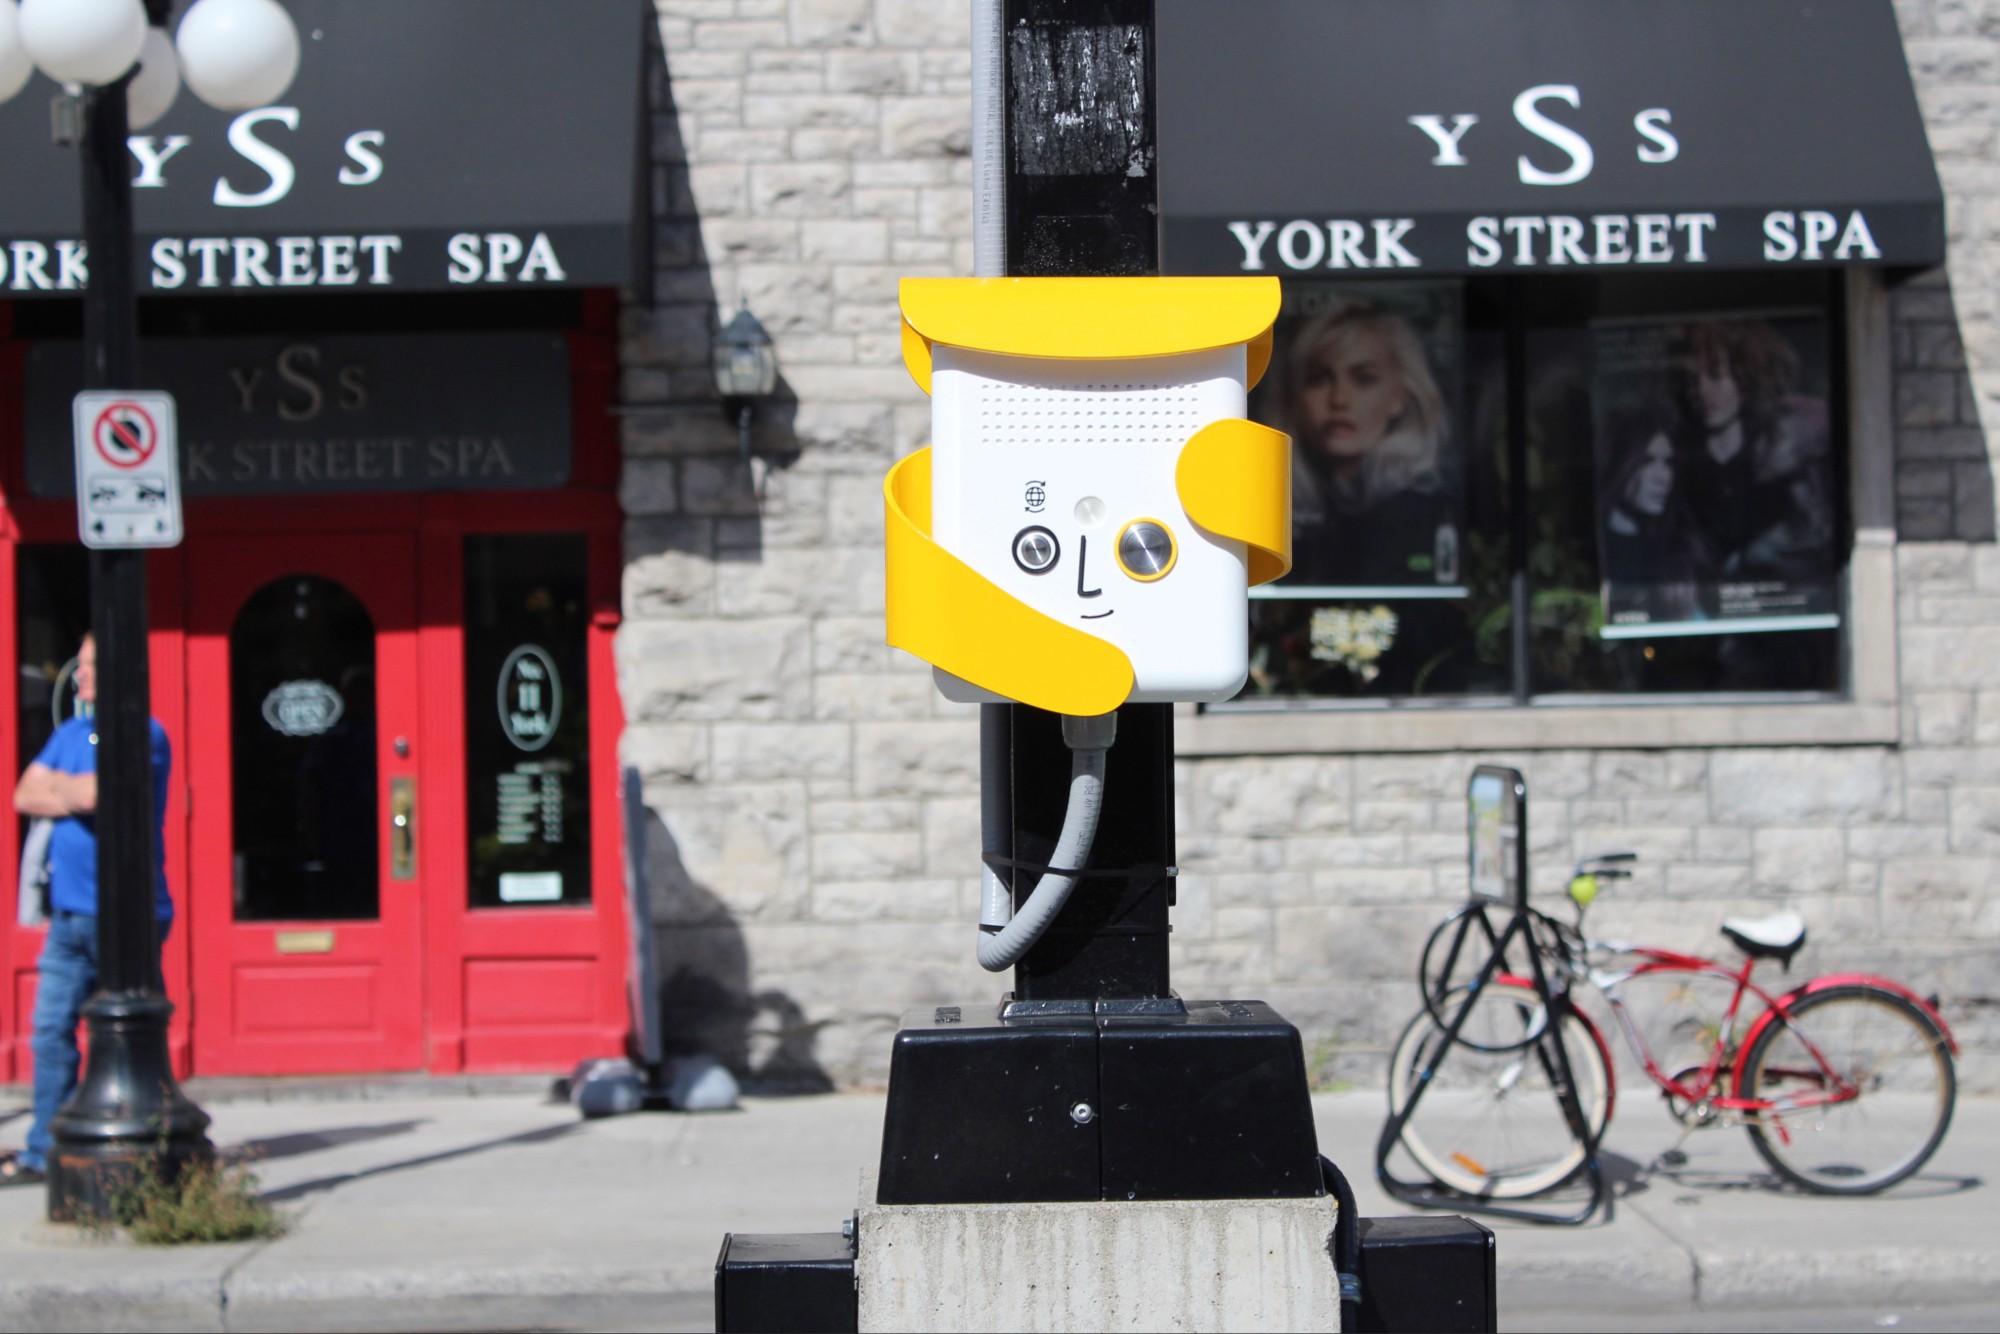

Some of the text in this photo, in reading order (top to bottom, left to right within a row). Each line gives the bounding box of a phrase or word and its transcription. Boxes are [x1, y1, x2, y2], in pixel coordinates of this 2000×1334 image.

[0, 233, 566, 290] RK STREET SPA
[1229, 210, 1881, 271] YORK STREET SPA
[231, 440, 413, 483] STREET
[426, 437, 515, 478] SPA
